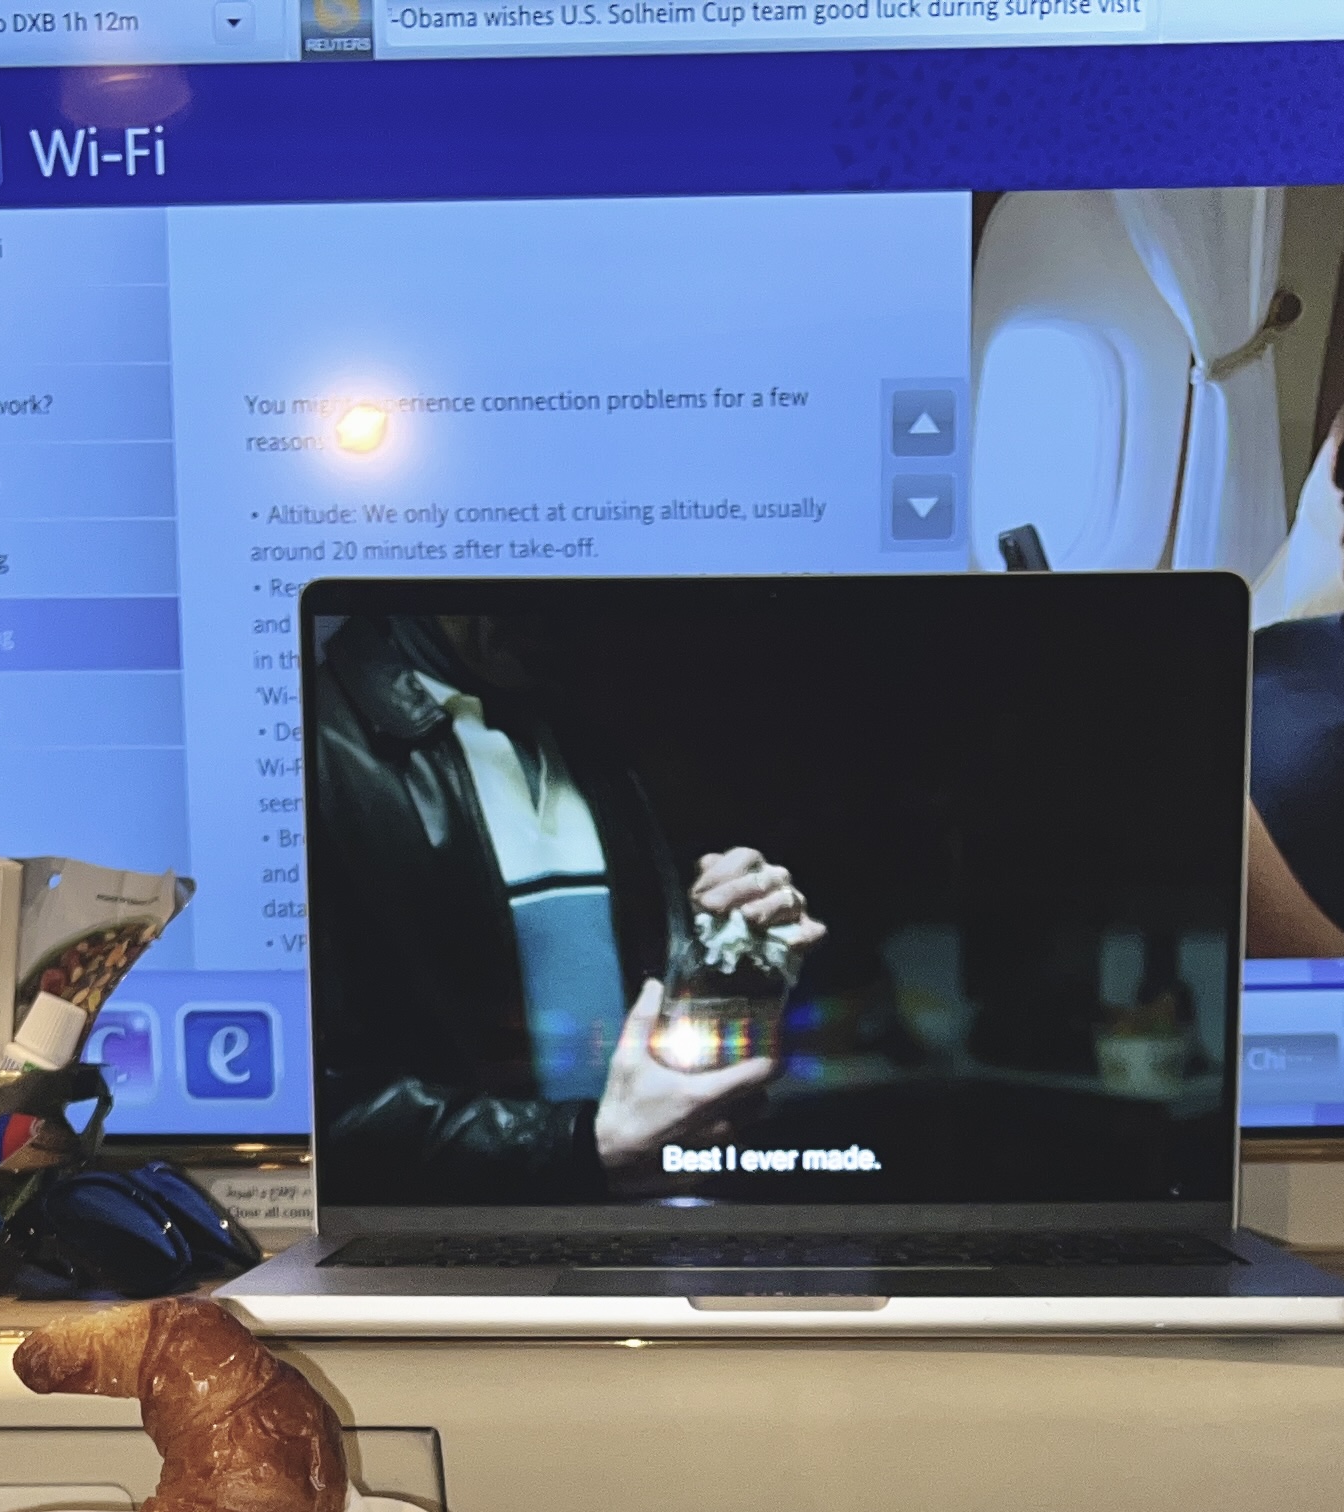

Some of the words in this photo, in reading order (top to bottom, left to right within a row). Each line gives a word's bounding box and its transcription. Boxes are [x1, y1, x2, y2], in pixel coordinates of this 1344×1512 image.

[12, 14, 56, 33] DXB
[62, 13, 88, 32] 1h
[95, 12, 140, 32] 12m
[486, 4, 554, 27] wishes
[561, 4, 602, 26] U.S.
[608, 2, 696, 25] Solheim
[702, 2, 747, 27] Cup
[752, 2, 807, 22] team
[814, 0, 869, 25] good
[876, 0, 922, 19] luck
[927, 0, 999, 21] during
[1005, 0, 1091, 20] surprise
[29, 126, 166, 178] Wi-Fi
[243, 394, 286, 416] You
[481, 390, 600, 413] connection
[607, 388, 708, 415] problems
[713, 388, 745, 410] for
[751, 392, 765, 408] a
[769, 386, 809, 408] few
[266, 503, 357, 525] Altitude:
[361, 503, 398, 524] We
[403, 502, 450, 529] only
[455, 503, 541, 524] connect
[547, 502, 567, 522] at
[571, 500, 655, 526] cruising
[660, 498, 748, 522] altitude,
[753, 496, 828, 523] usually
[250, 541, 326, 563] around
[332, 540, 358, 561] 20
[362, 540, 448, 561] minutes
[452, 538, 504, 560] after
[508, 536, 600, 559] take-off.
[253, 615, 291, 635] and
[254, 650, 273, 670] in
[262, 863, 300, 884] and
[662, 1143, 722, 1173] Best
[725, 1144, 738, 1172] I
[739, 1148, 800, 1173] ever
[801, 1143, 883, 1173] made.
